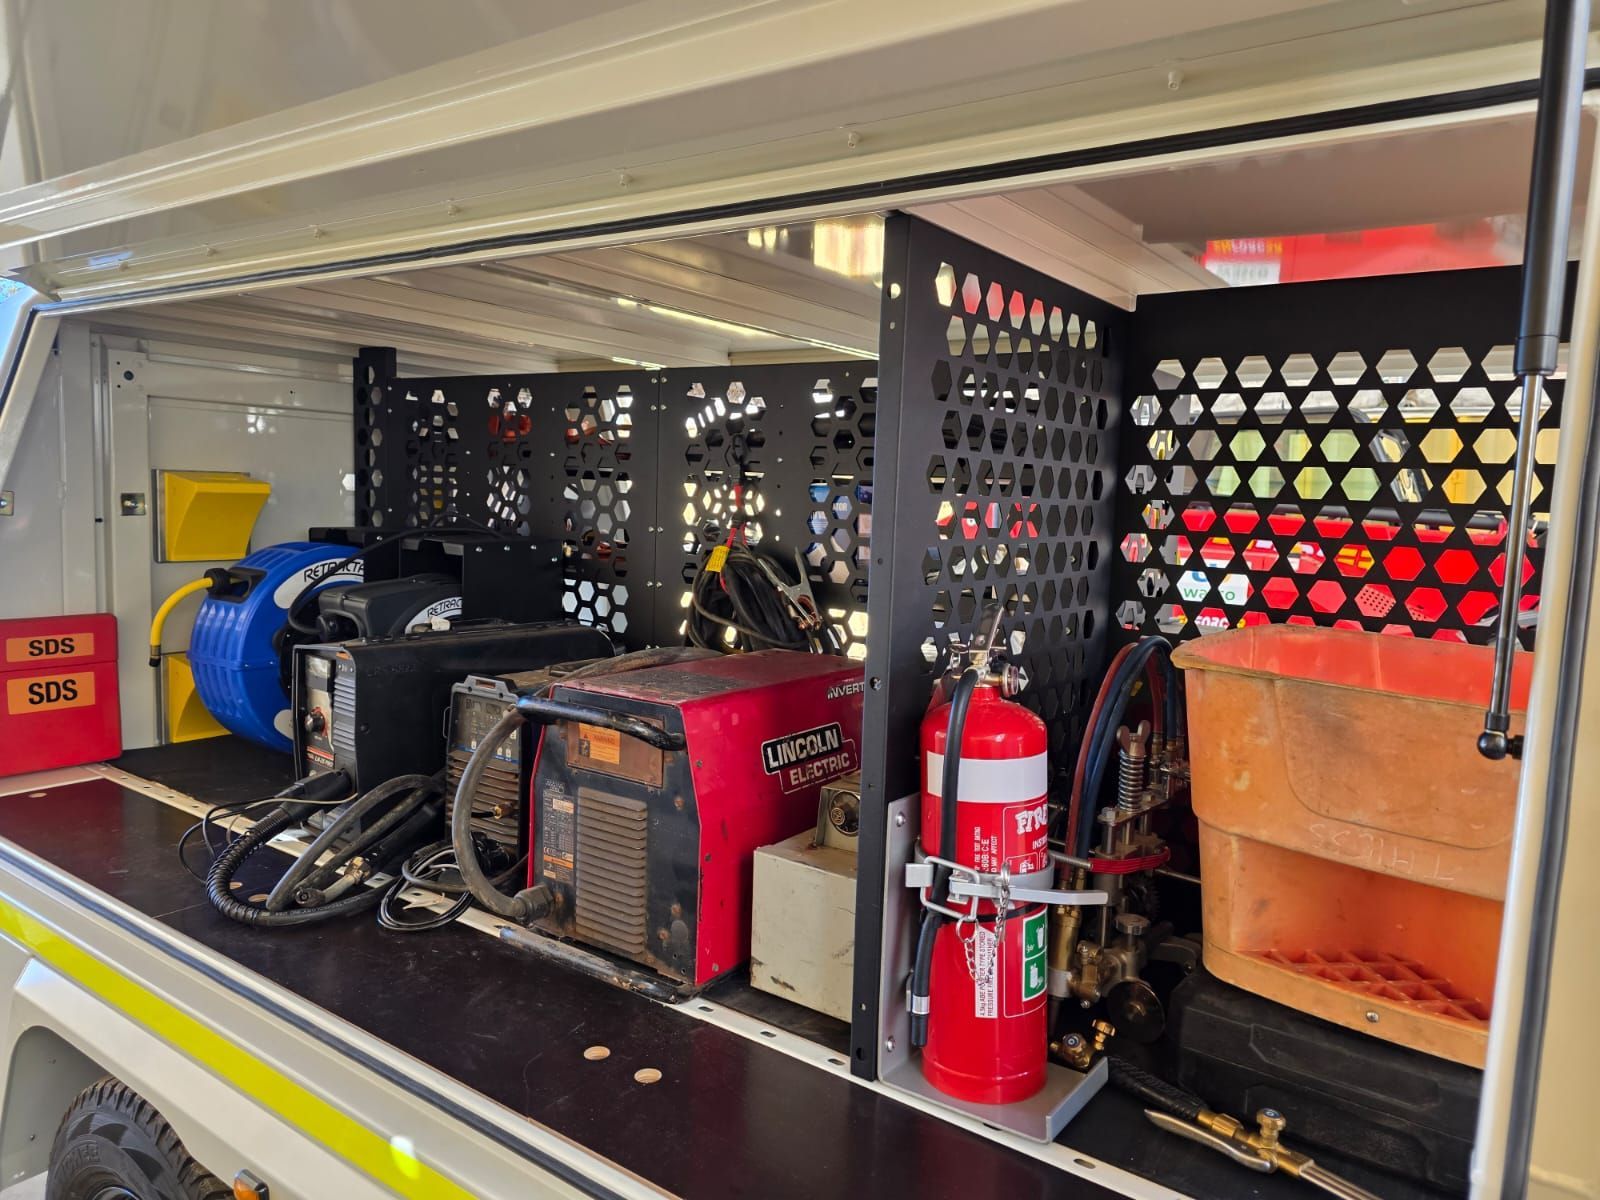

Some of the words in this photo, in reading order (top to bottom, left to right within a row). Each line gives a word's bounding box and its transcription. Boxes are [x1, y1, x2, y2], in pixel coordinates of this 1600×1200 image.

[28, 637, 75, 657] SDS
[28, 678, 78, 705] SDS
[766, 728, 840, 769] LINCOLN
[789, 752, 850, 786] ELECTRIC
